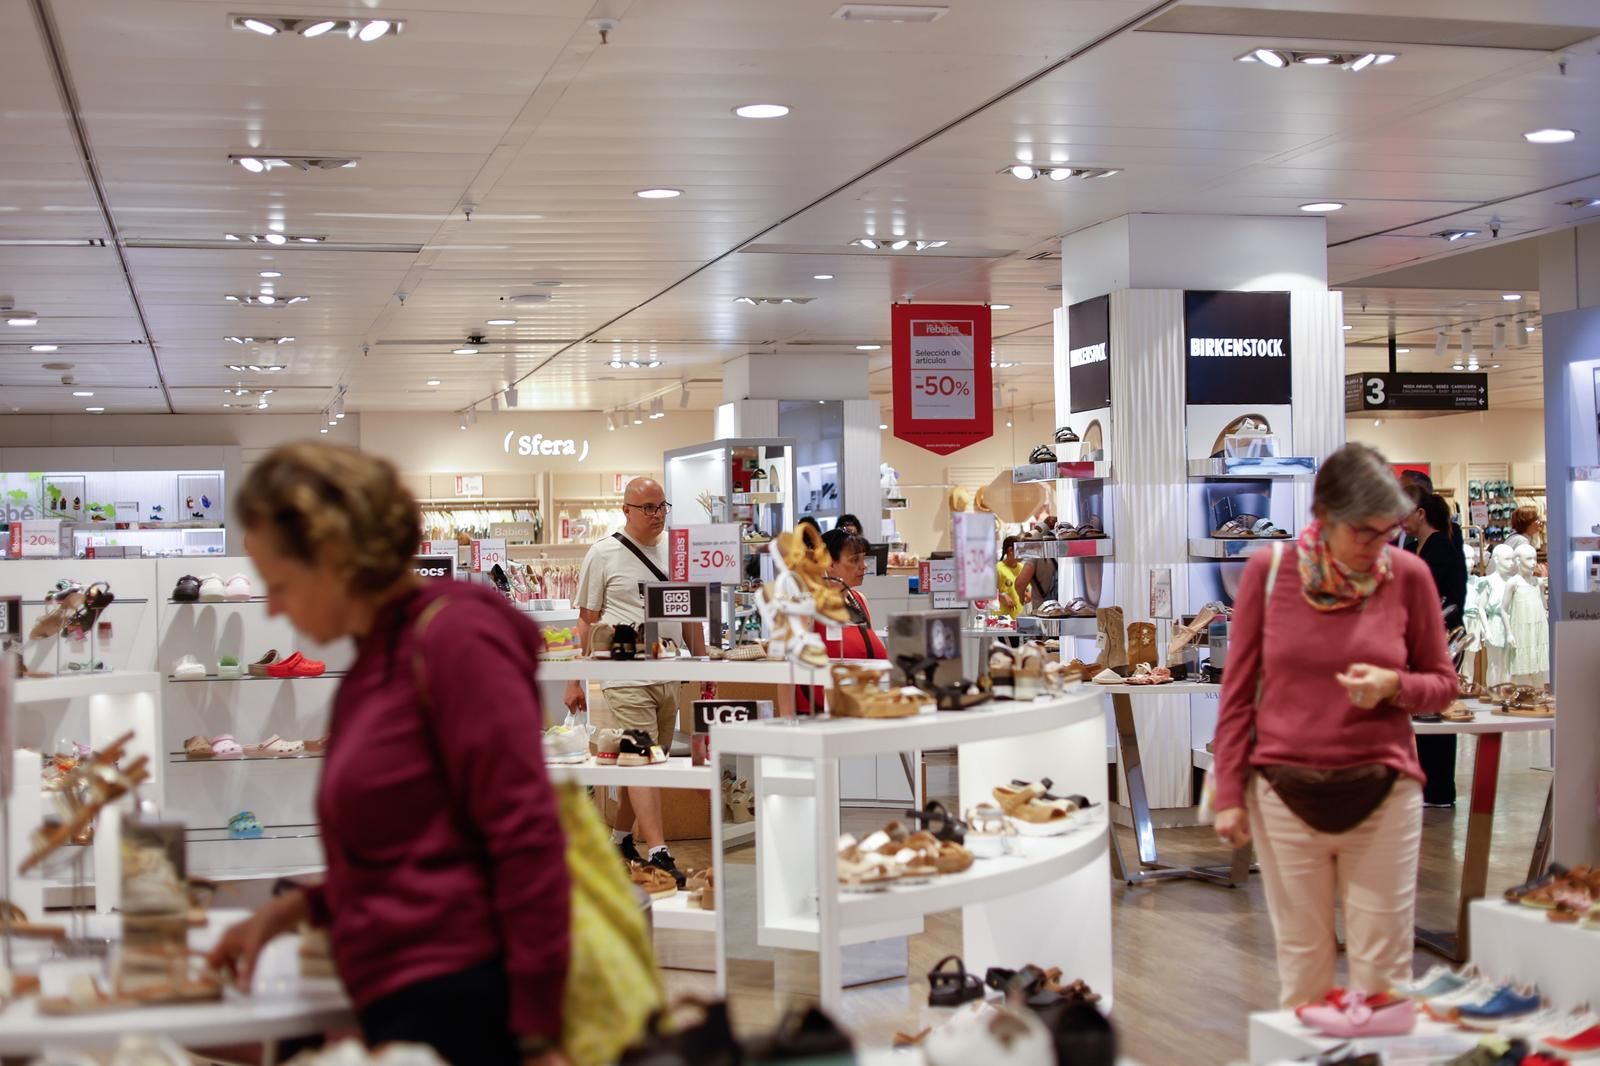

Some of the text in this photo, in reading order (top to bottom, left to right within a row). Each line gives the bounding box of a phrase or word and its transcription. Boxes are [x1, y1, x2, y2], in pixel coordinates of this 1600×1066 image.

[915, 349, 961, 357] Selección de
[1190, 338, 1285, 357] BIRKENSTOCK
[915, 376, 970, 396] -50%
[1366, 377, 1385, 404] 3
[494, 527, 529, 536] Babies
[24, 535, 56, 546] -20%
[673, 537, 686, 581] rebajas
[692, 550, 736, 568] -30%
[412, 567, 445, 577] rocs
[932, 573, 952, 583] -50
[665, 592, 689, 603] GIOS
[665, 604, 689, 613] EPPO
[703, 705, 749, 726] UGG
